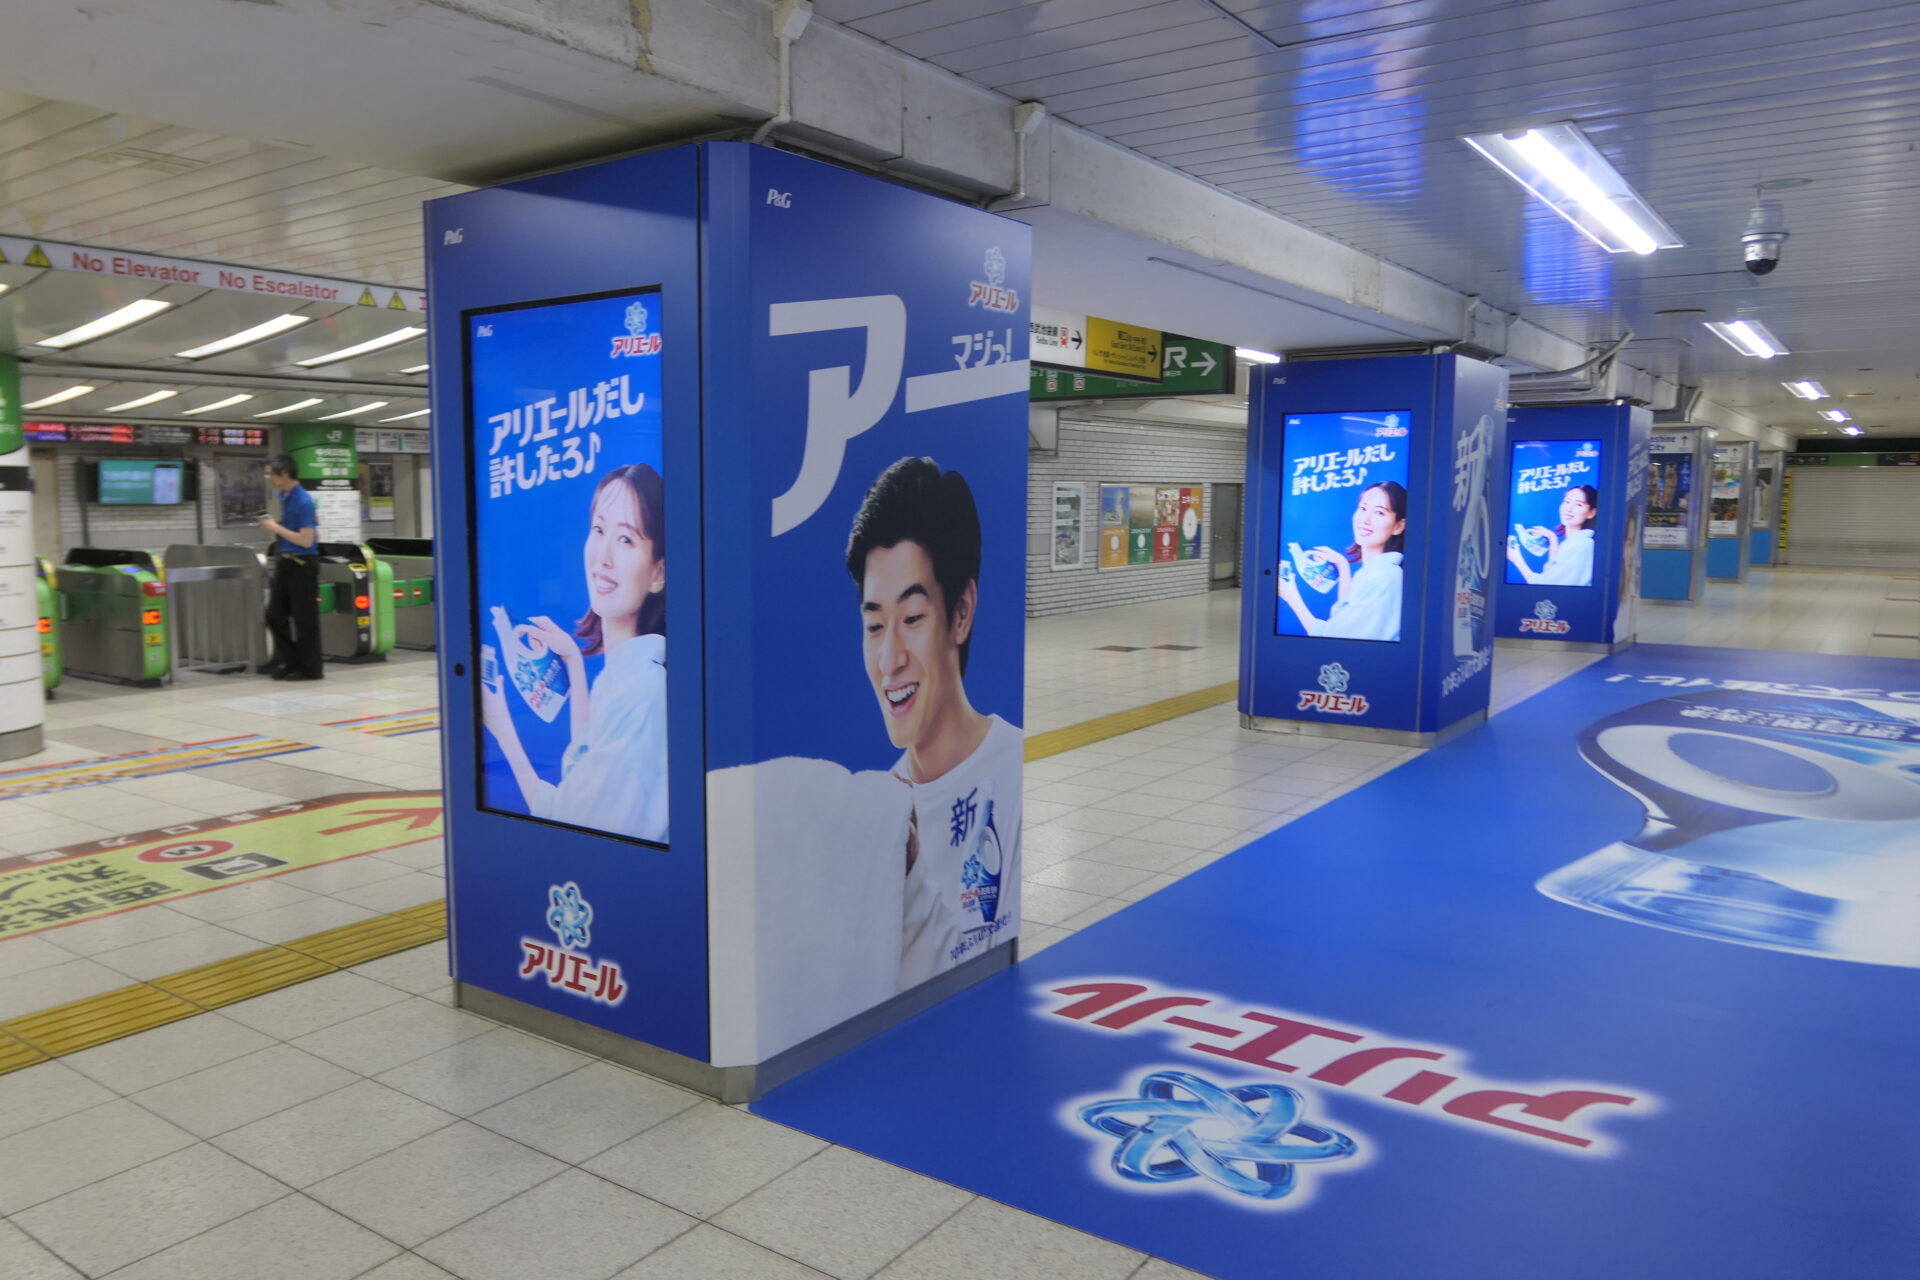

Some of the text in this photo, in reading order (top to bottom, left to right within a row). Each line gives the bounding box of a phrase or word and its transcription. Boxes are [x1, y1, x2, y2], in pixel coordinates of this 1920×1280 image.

[767, 189, 792, 208] P&G
[444, 228, 464, 245] P&G
[72, 252, 338, 300] No Elevator No Escalator
[971, 283, 1018, 312] アリエール
[612, 335, 662, 357] アリエール
[488, 374, 644, 455] アリエールだし
[1293, 444, 1396, 477] アリエールだし
[1518, 461, 1590, 482] アリエールだし
[1299, 691, 1367, 714] アリエール
[950, 787, 977, 847] 新
[522, 942, 623, 1001] アリエール
[1051, 982, 1637, 1148] アリエール
